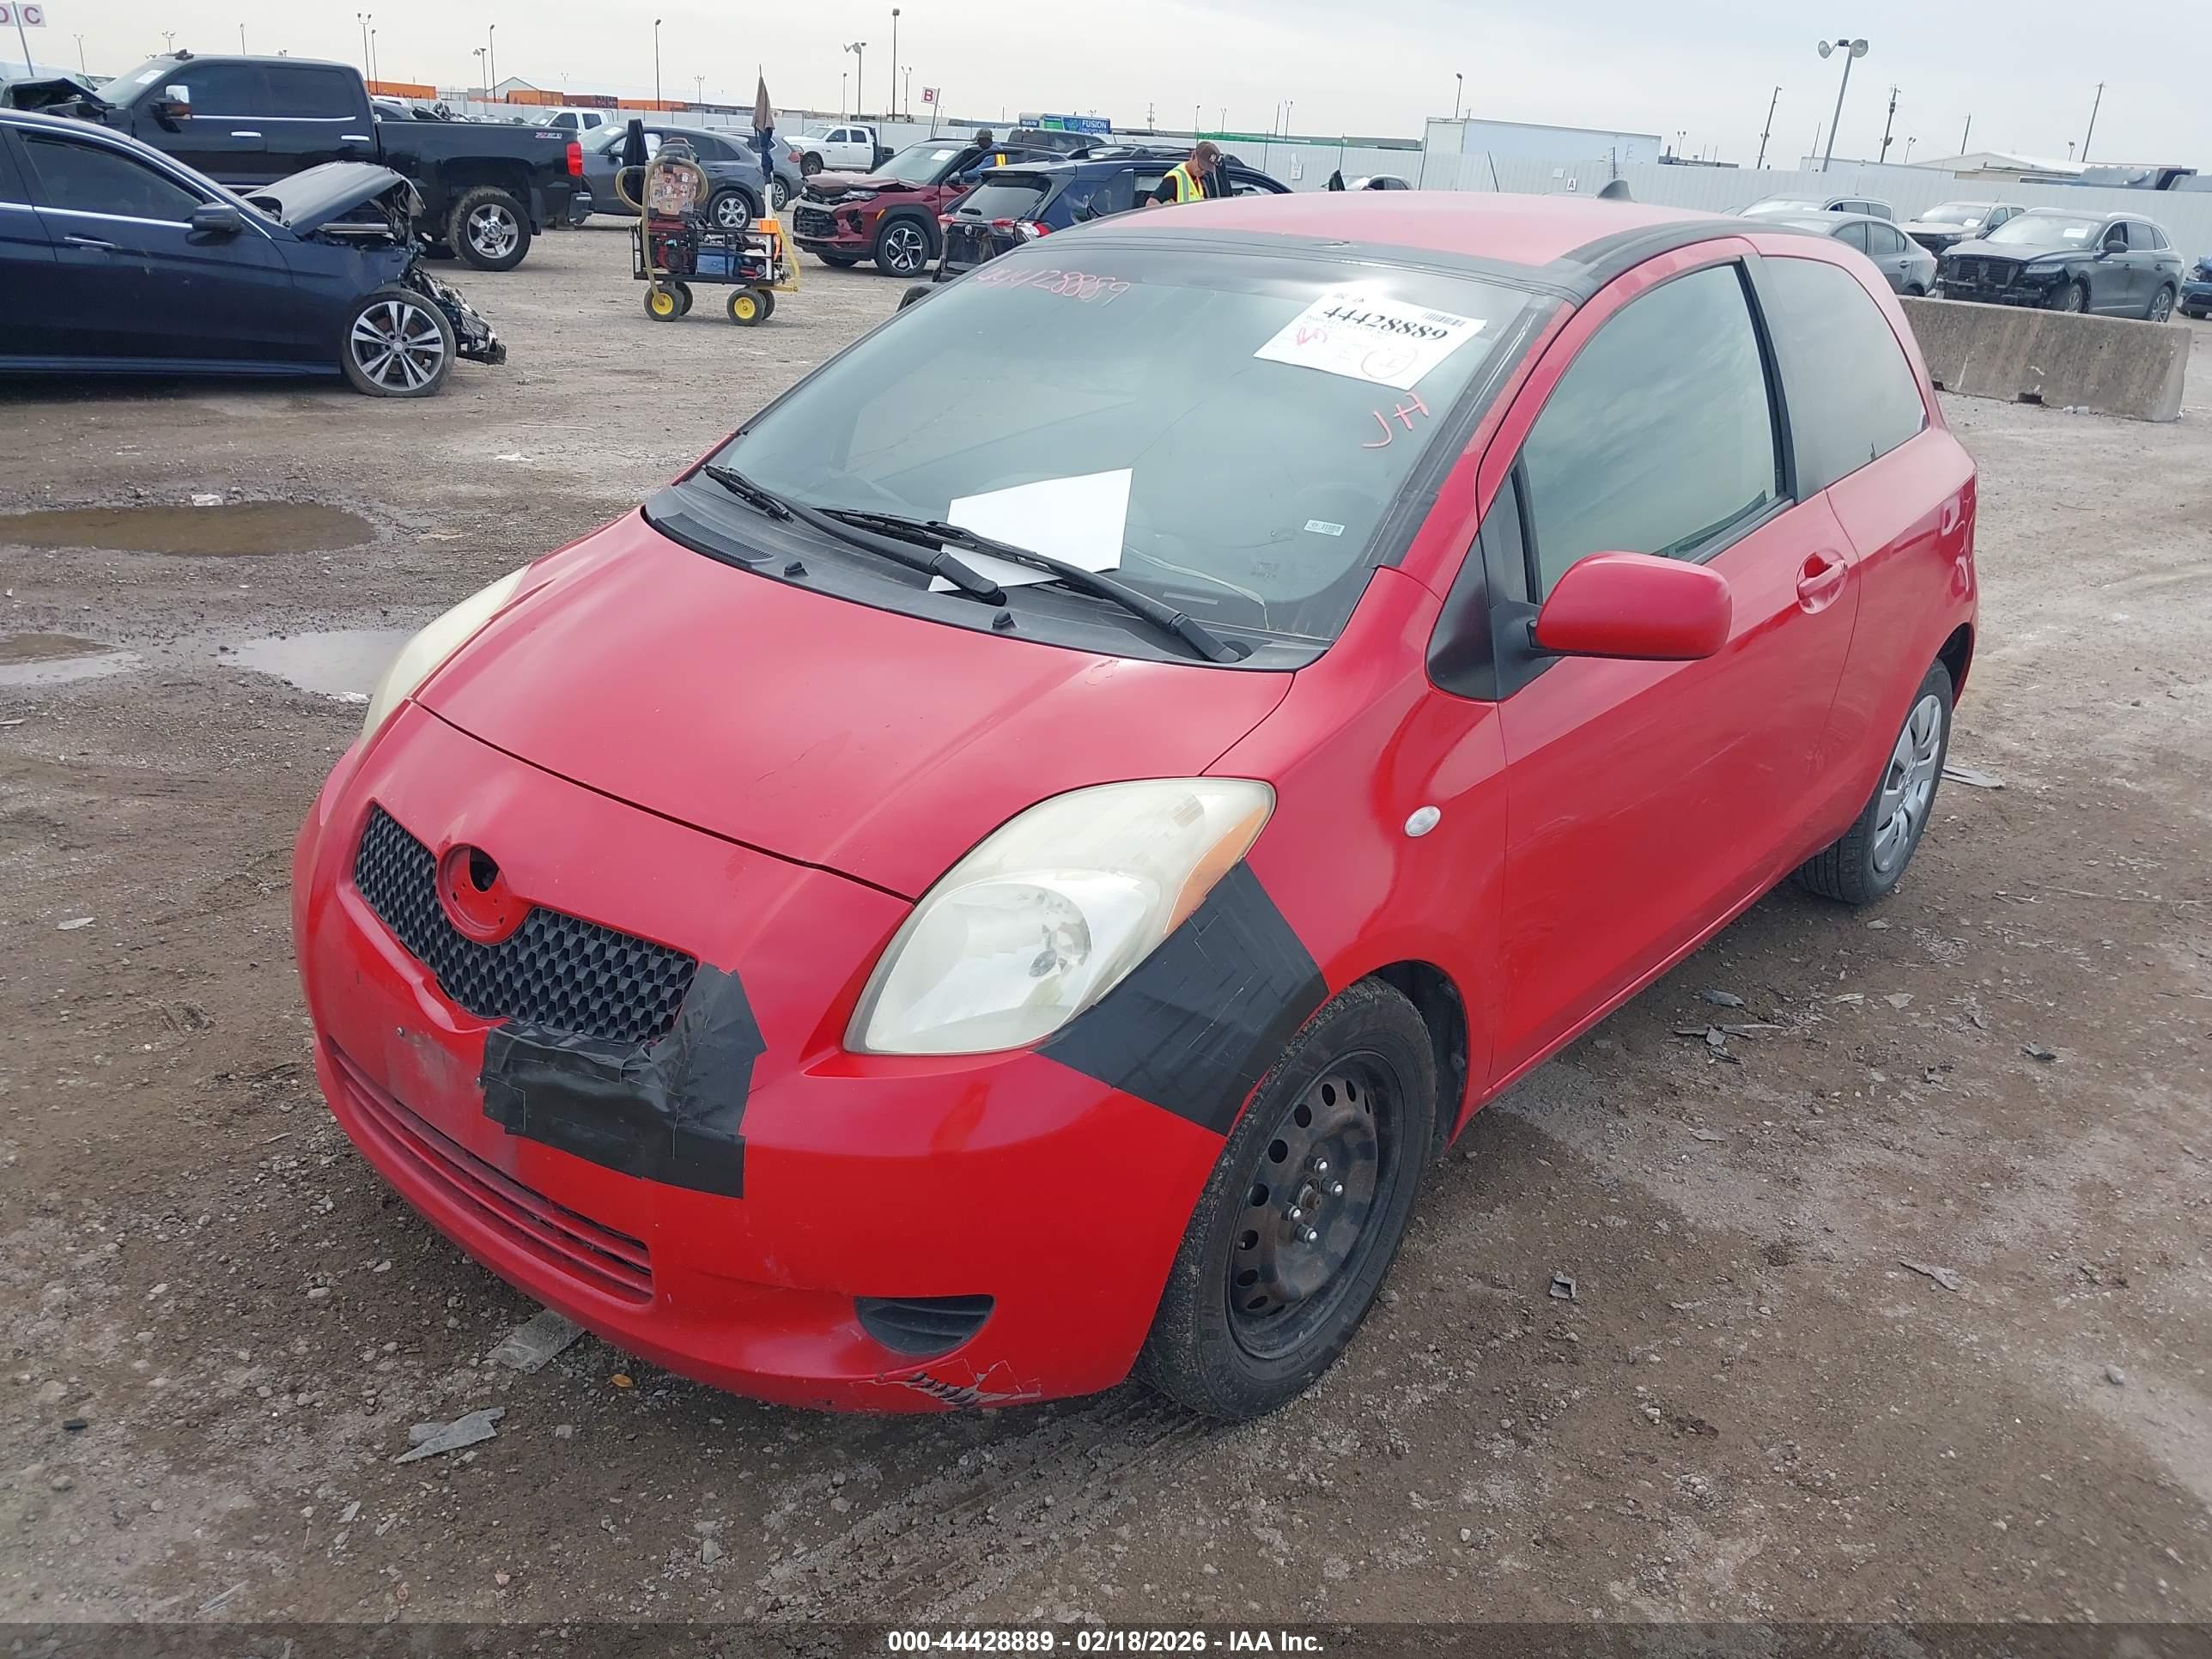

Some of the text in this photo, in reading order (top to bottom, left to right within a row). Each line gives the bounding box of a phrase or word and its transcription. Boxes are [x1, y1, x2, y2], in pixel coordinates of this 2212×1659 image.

[24, 6, 41, 24] C
[924, 88, 933, 101] B
[1082, 119, 1107, 129] FUSION
[1568, 179, 1574, 189] A
[1323, 306, 1448, 341] 44428889
